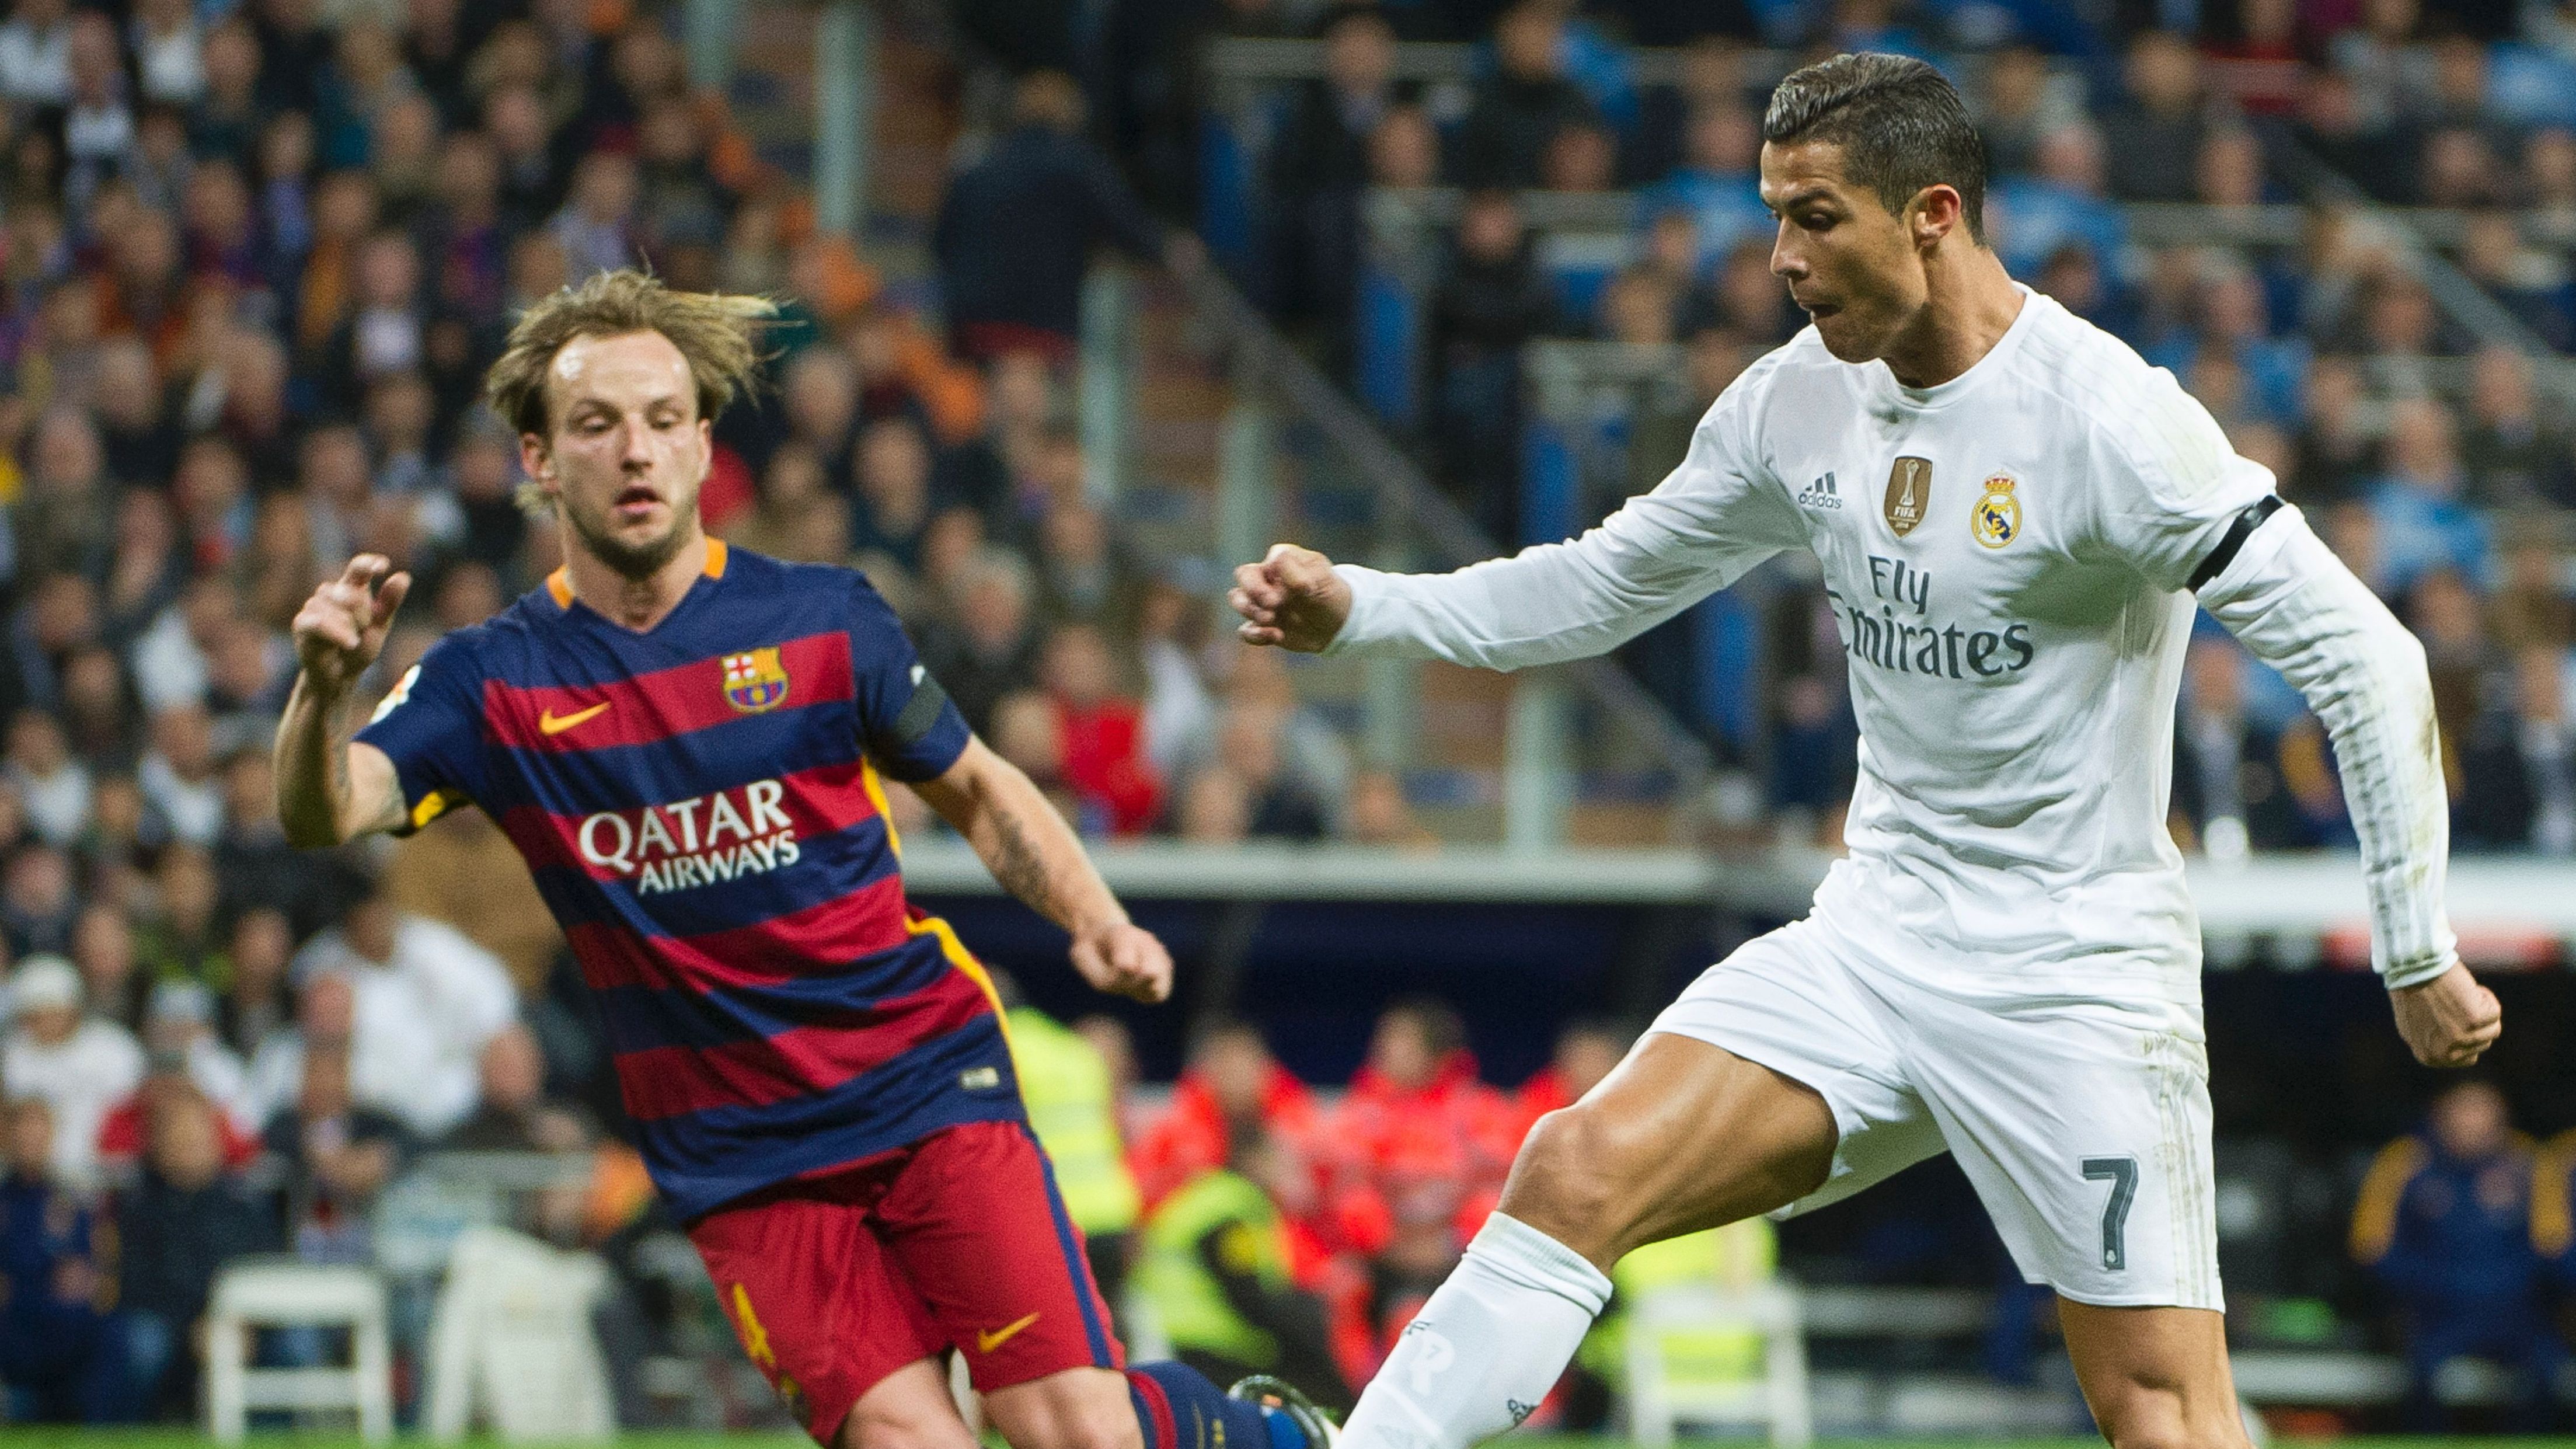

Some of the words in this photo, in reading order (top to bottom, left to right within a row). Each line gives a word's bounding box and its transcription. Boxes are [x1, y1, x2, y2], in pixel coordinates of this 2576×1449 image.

[1798, 492, 1842, 510] adidas
[1894, 505, 1915, 518] FIFA
[1868, 555, 1930, 614] Fly
[578, 779, 793, 873] QATAR
[639, 828, 801, 896] AIRWAYS
[2079, 1155, 2139, 1270] 7
